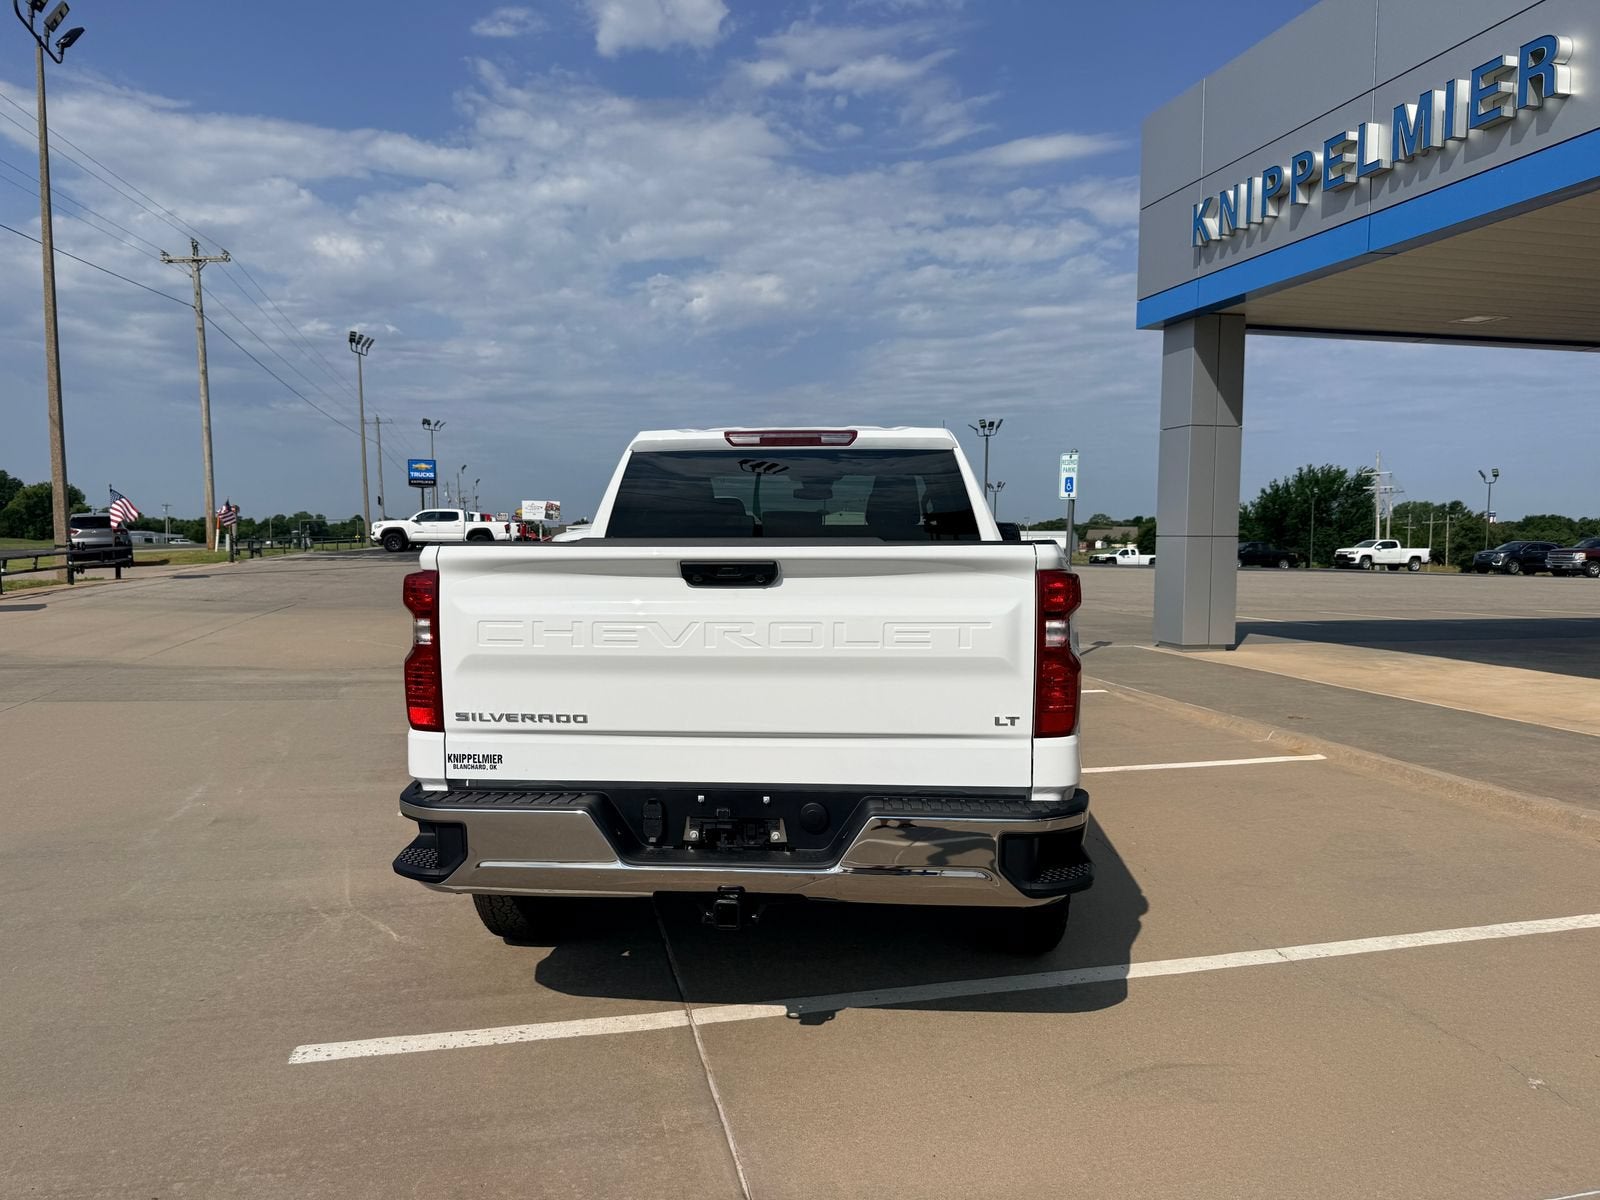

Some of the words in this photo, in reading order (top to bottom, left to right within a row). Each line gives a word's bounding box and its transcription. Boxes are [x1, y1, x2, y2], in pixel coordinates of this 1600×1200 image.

[1192, 34, 1572, 247] KNIPPELMIER
[476, 619, 993, 650] CHEVROLET
[455, 712, 588, 724] SILVERADO
[995, 716, 1020, 726] LT
[447, 753, 503, 764] KNIPPELMIER
